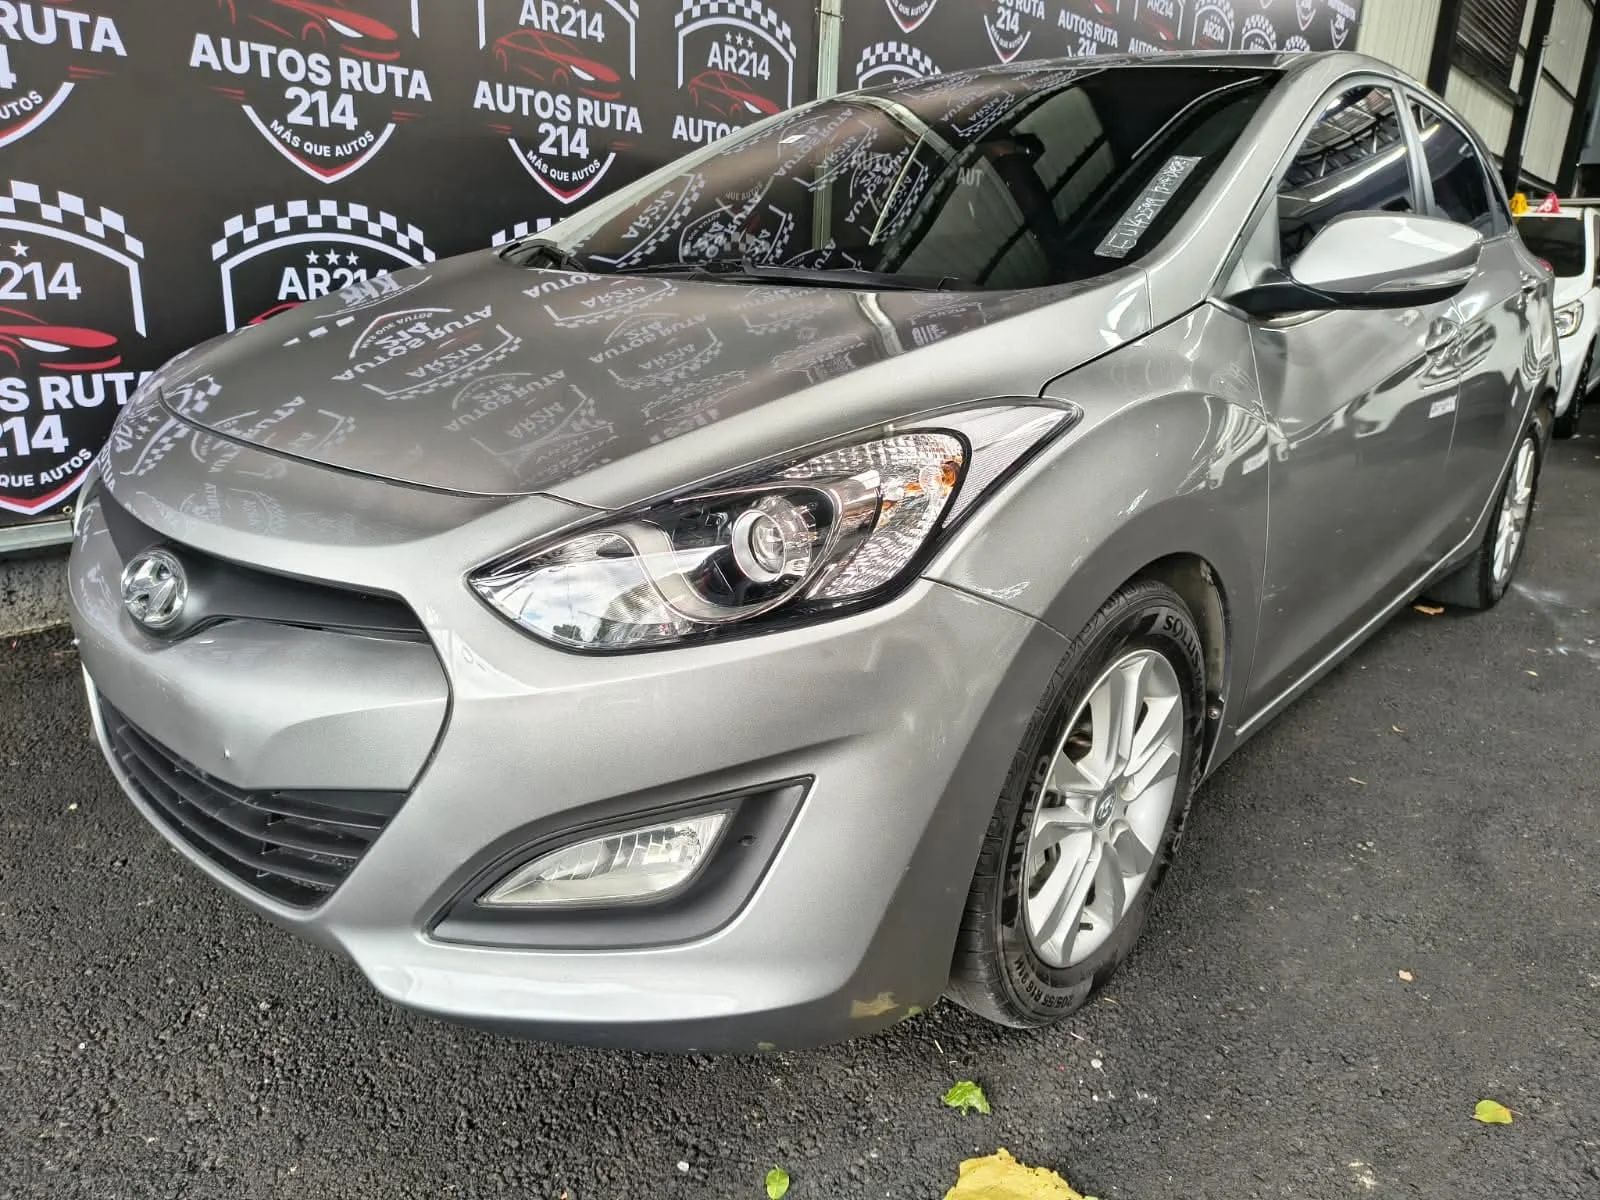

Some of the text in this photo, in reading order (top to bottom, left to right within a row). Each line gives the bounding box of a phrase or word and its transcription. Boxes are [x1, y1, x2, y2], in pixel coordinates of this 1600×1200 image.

[518, 0, 606, 43] AR214
[995, 6, 1020, 35] 214
[1057, 8, 1119, 49] AUTOS RUTA
[189, 33, 433, 102] AUTOS RUTA
[707, 41, 770, 80] AR214
[284, 86, 359, 131] 214
[473, 80, 643, 134] AUTOS RUTA
[269, 118, 375, 157] MÁS QUE AUTOS
[537, 122, 589, 160] 214
[526, 150, 601, 182] MÁS QUE AUTOS
[40, 448, 92, 485] AUTOS
